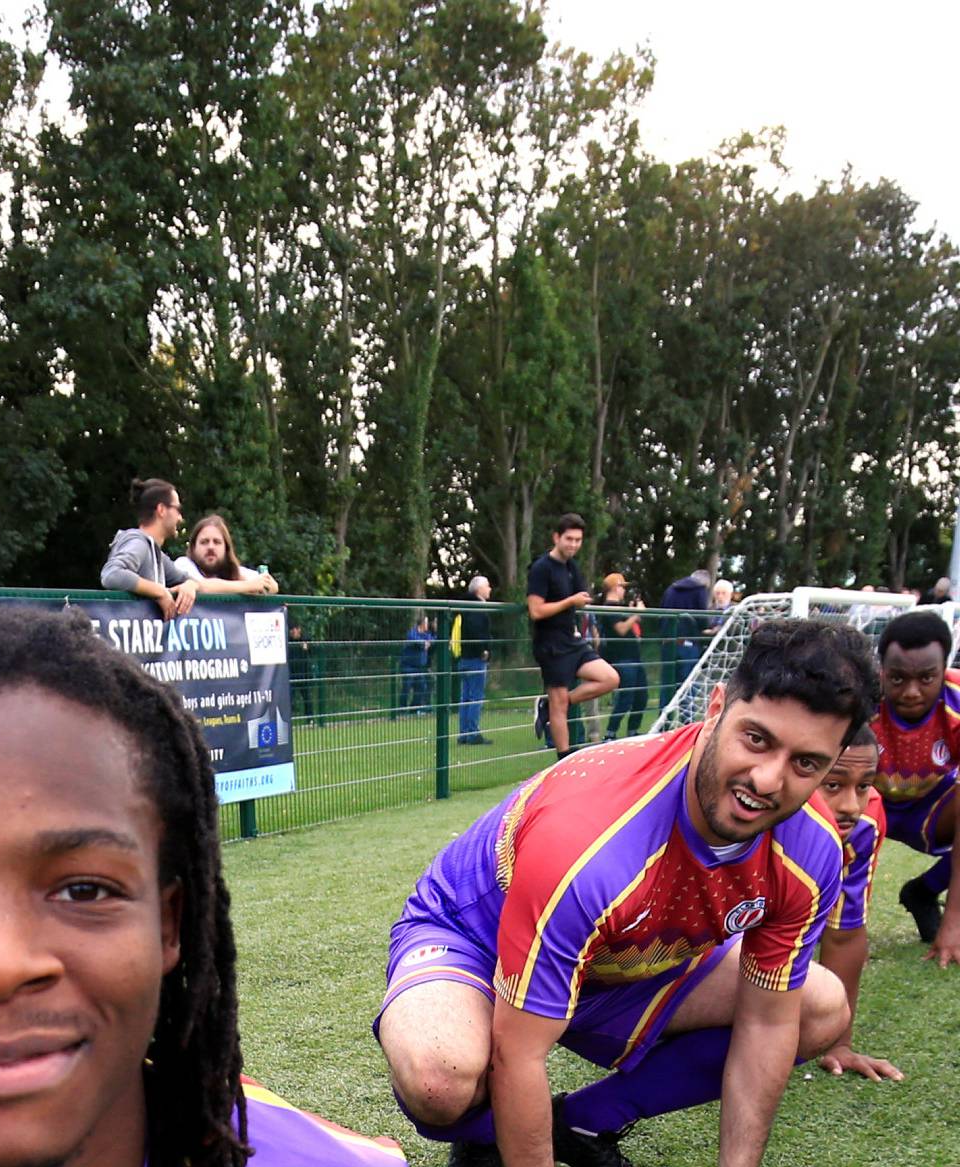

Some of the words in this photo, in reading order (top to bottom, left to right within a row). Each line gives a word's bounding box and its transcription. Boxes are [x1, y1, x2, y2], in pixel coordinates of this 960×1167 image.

[108, 619, 164, 653] STARZ
[167, 617, 227, 652] ACTON
[185, 658, 239, 680] PROGRAM
[182, 695, 198, 711] boys
[200, 693, 215, 708] and
[217, 692, 235, 710] girls
[236, 690, 251, 708] aged
